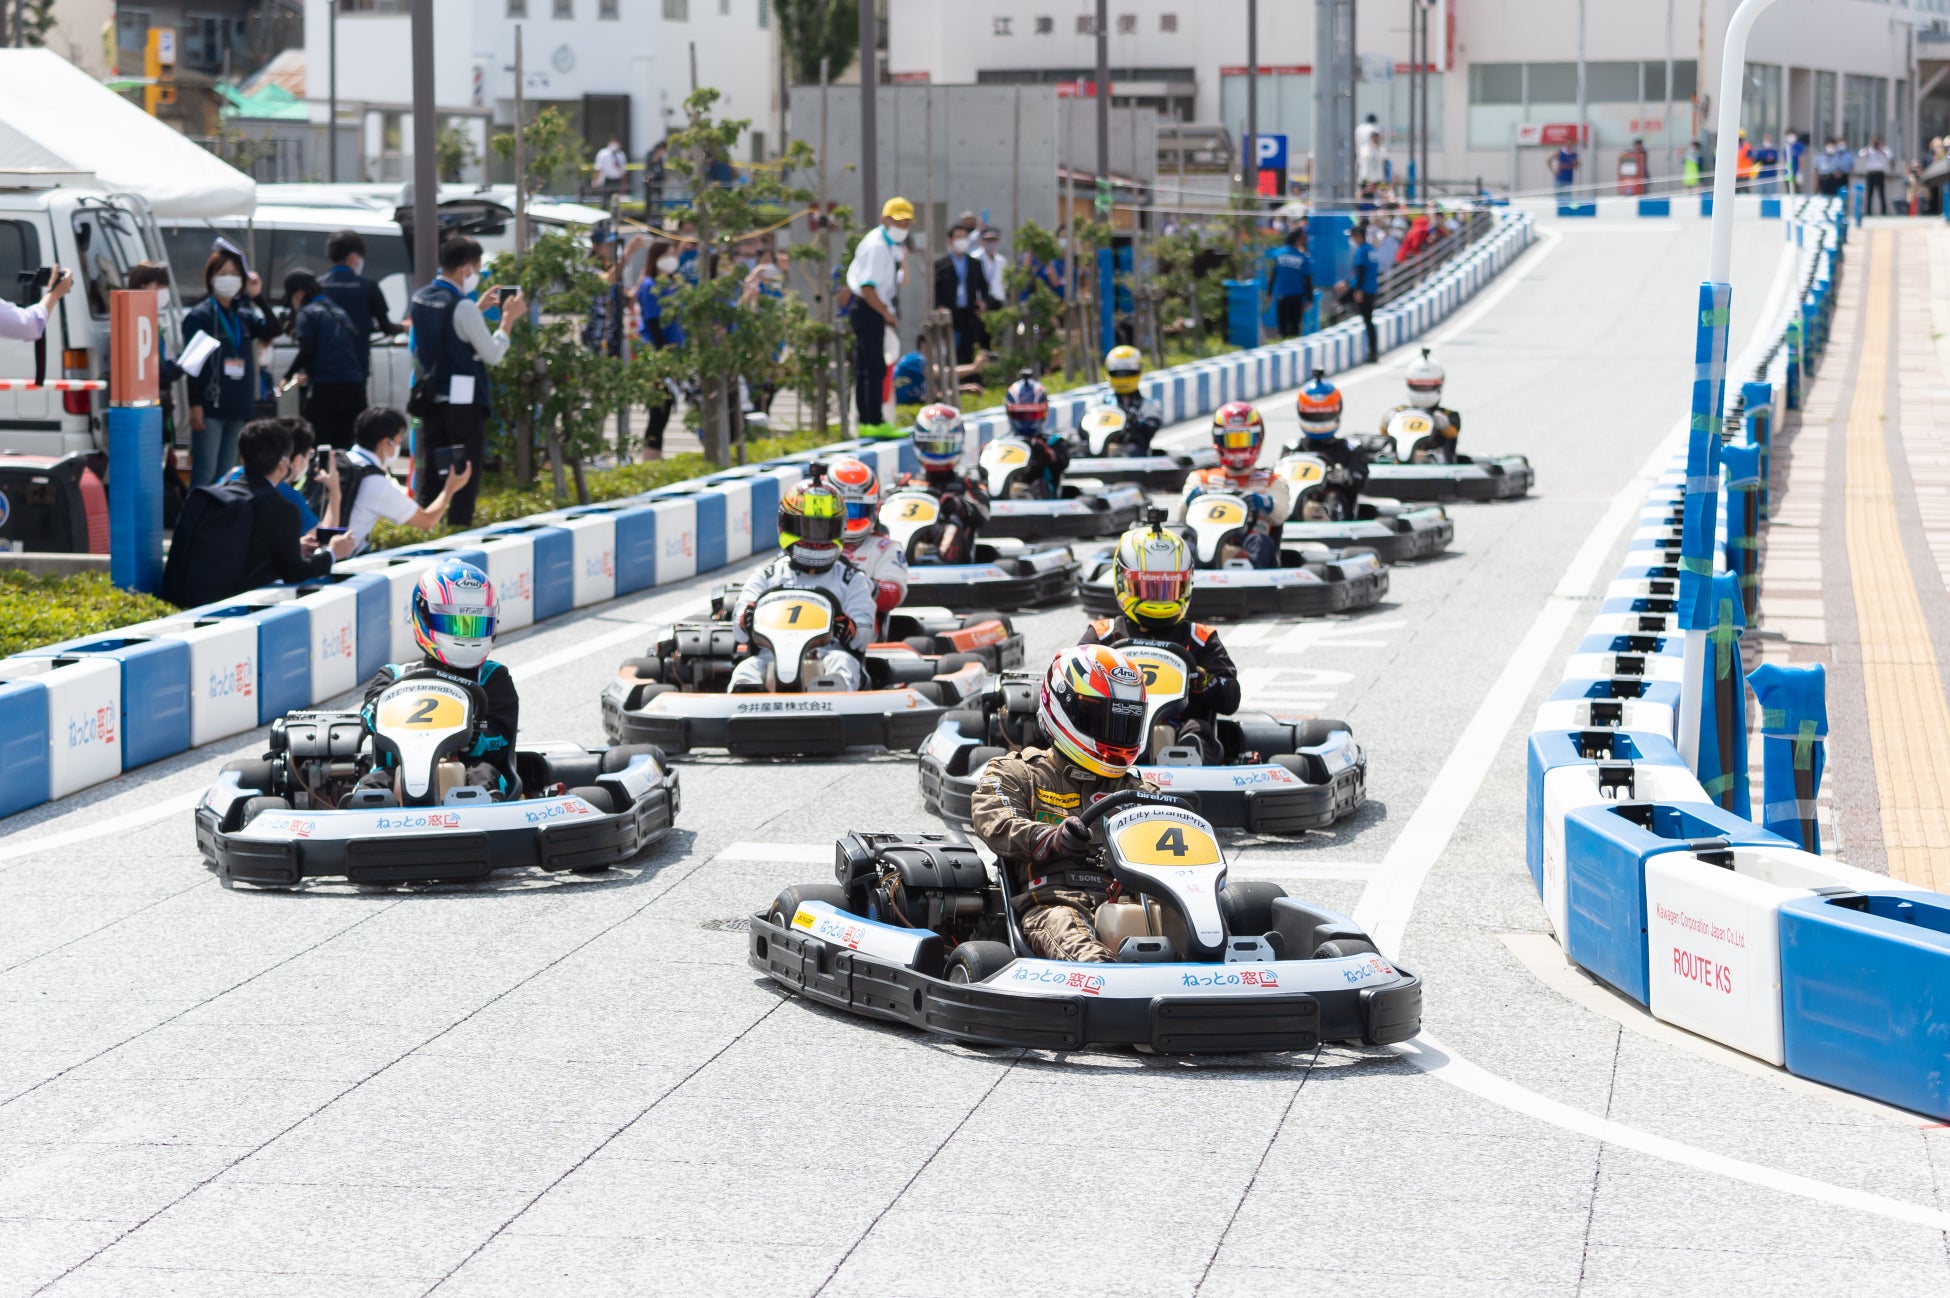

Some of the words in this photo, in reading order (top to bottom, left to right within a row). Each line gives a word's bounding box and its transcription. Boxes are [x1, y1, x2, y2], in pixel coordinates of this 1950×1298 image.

[1256, 137, 1280, 166] P
[137, 316, 152, 381] P
[901, 503, 919, 517] 3
[1208, 505, 1227, 519] 6
[786, 605, 802, 624] 1
[436, 670, 472, 686] birelART
[1138, 664, 1160, 687] 5
[405, 698, 439, 724] 2
[737, 701, 833, 713] 今井産業株式会社
[1041, 794, 1080, 805] DUNLOP
[1136, 790, 1178, 803] birelART
[1116, 817, 1128, 830] A1
[1129, 811, 1150, 822] City
[1153, 809, 1207, 830] GrandPrix
[1155, 827, 1189, 856] 4
[1079, 874, 1102, 884] SONE
[1656, 902, 1680, 926] Kawagen
[1680, 911, 1710, 937] Corporation
[1711, 922, 1726, 942] Japan
[1673, 947, 1712, 988] ROUTE
[1715, 962, 1732, 995] KS
